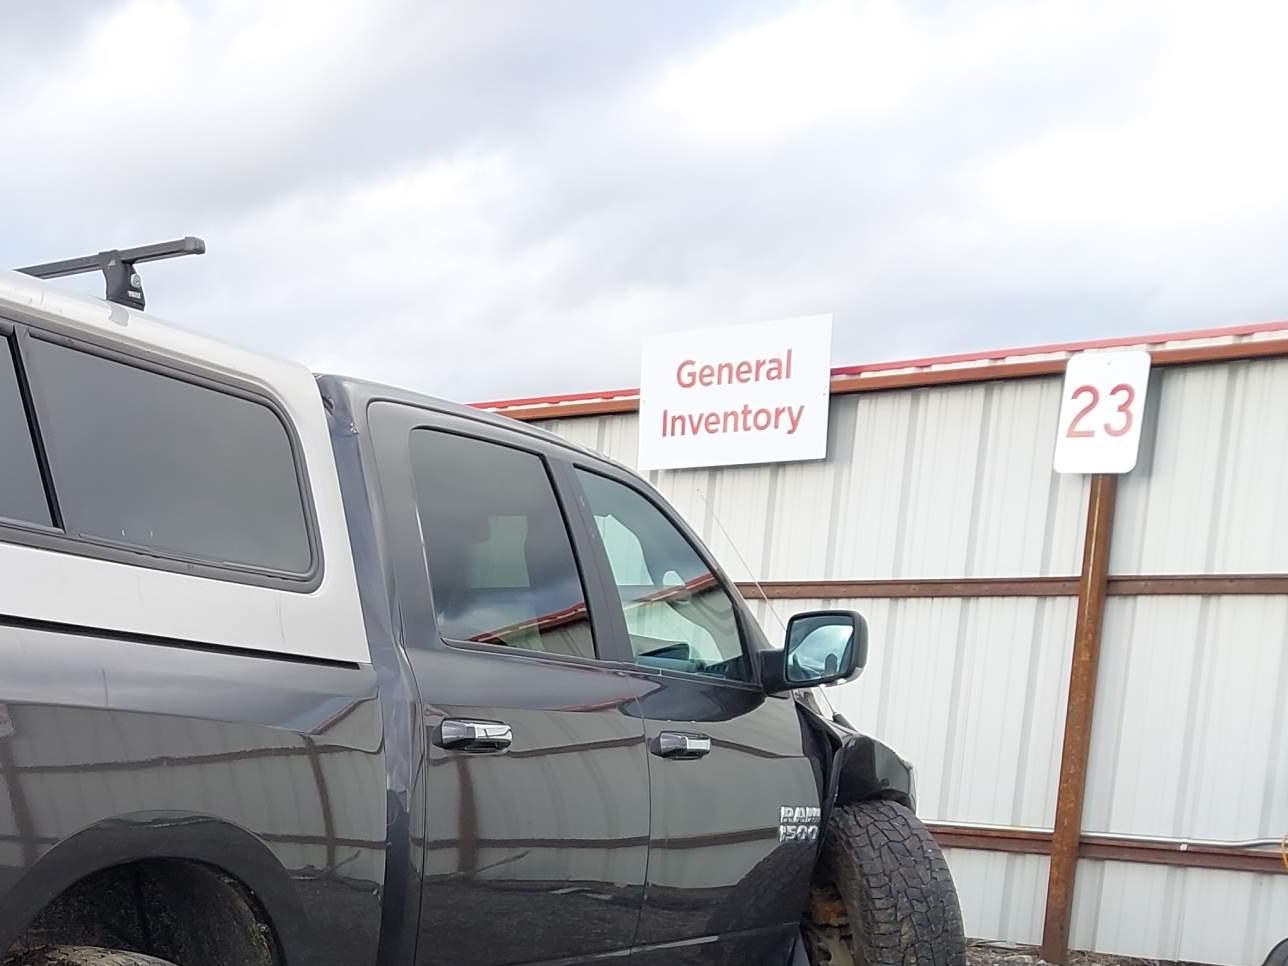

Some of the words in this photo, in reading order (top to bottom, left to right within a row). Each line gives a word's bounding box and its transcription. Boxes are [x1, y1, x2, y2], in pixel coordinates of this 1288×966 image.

[676, 348, 793, 389] General
[661, 403, 805, 438] Inventory
[1065, 383, 1136, 438] 23
[779, 806, 821, 823] RAM
[779, 824, 819, 842] 1500
